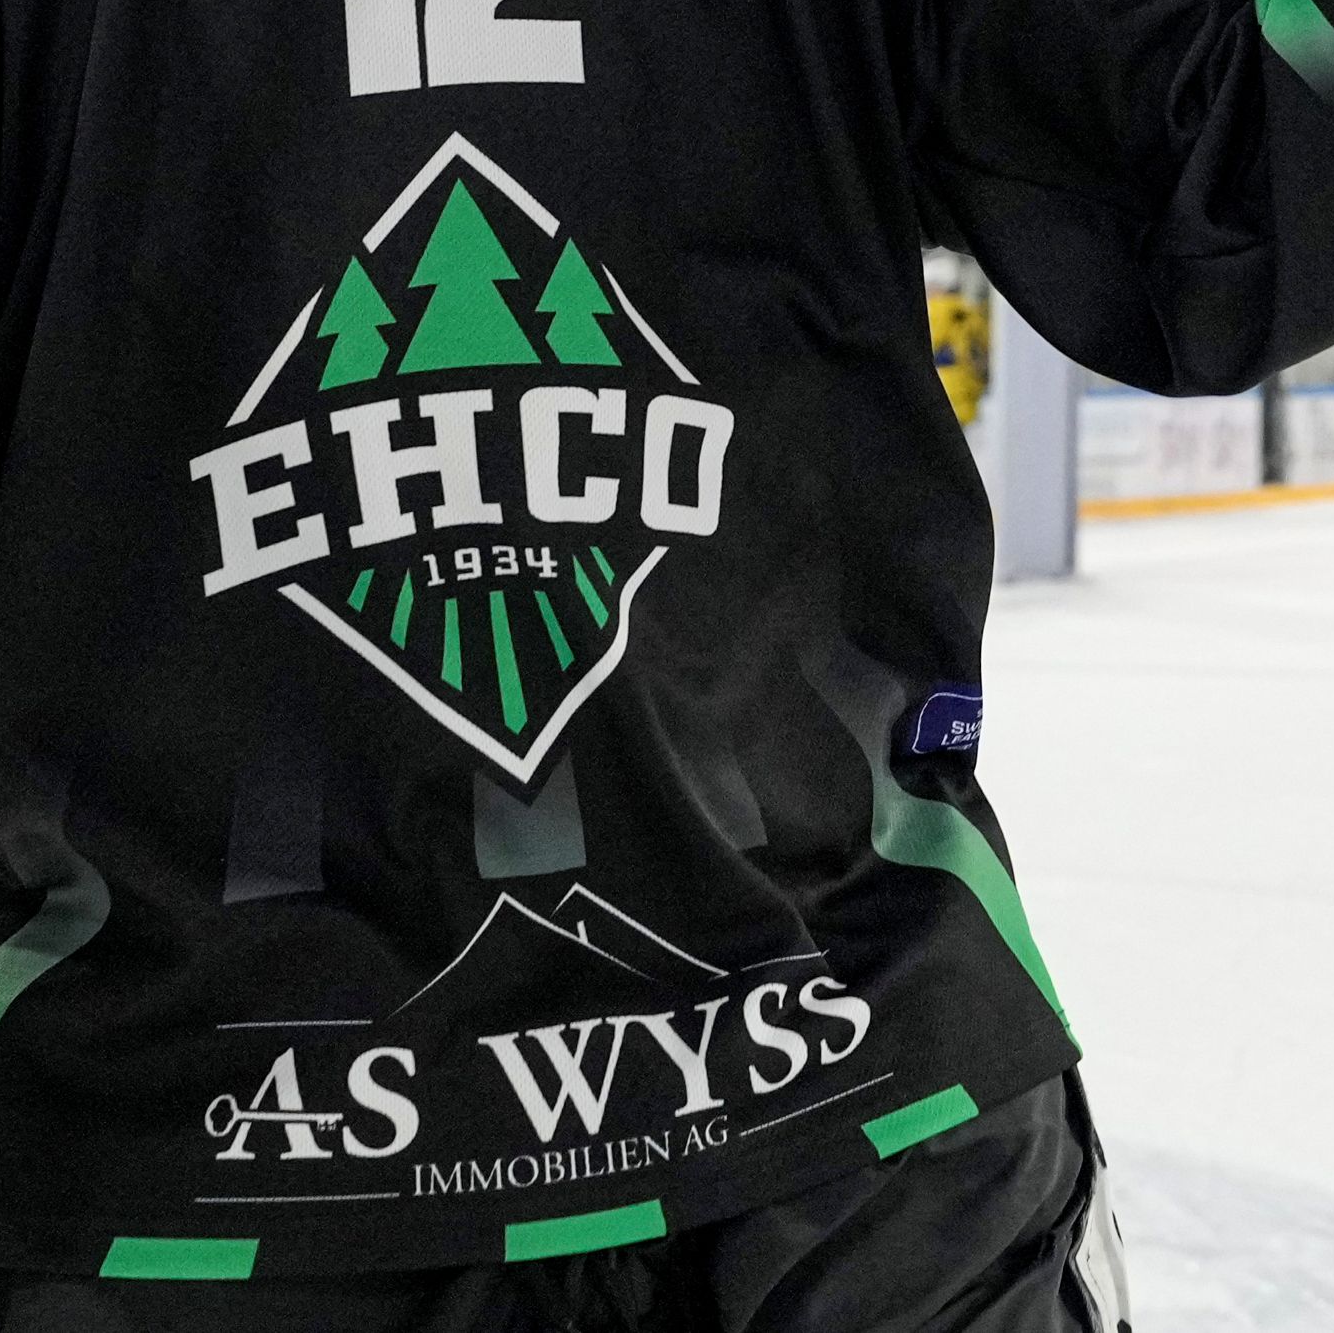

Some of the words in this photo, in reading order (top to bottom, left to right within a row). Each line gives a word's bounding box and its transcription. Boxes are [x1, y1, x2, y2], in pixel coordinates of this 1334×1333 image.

[188, 385, 735, 598] EHCO
[422, 545, 559, 587] 1934
[204, 1046, 421, 1162] AS
[477, 974, 872, 1144] WYSS
[412, 1131, 670, 1197] IMMOBILIEN
[681, 1115, 730, 1157] AG
